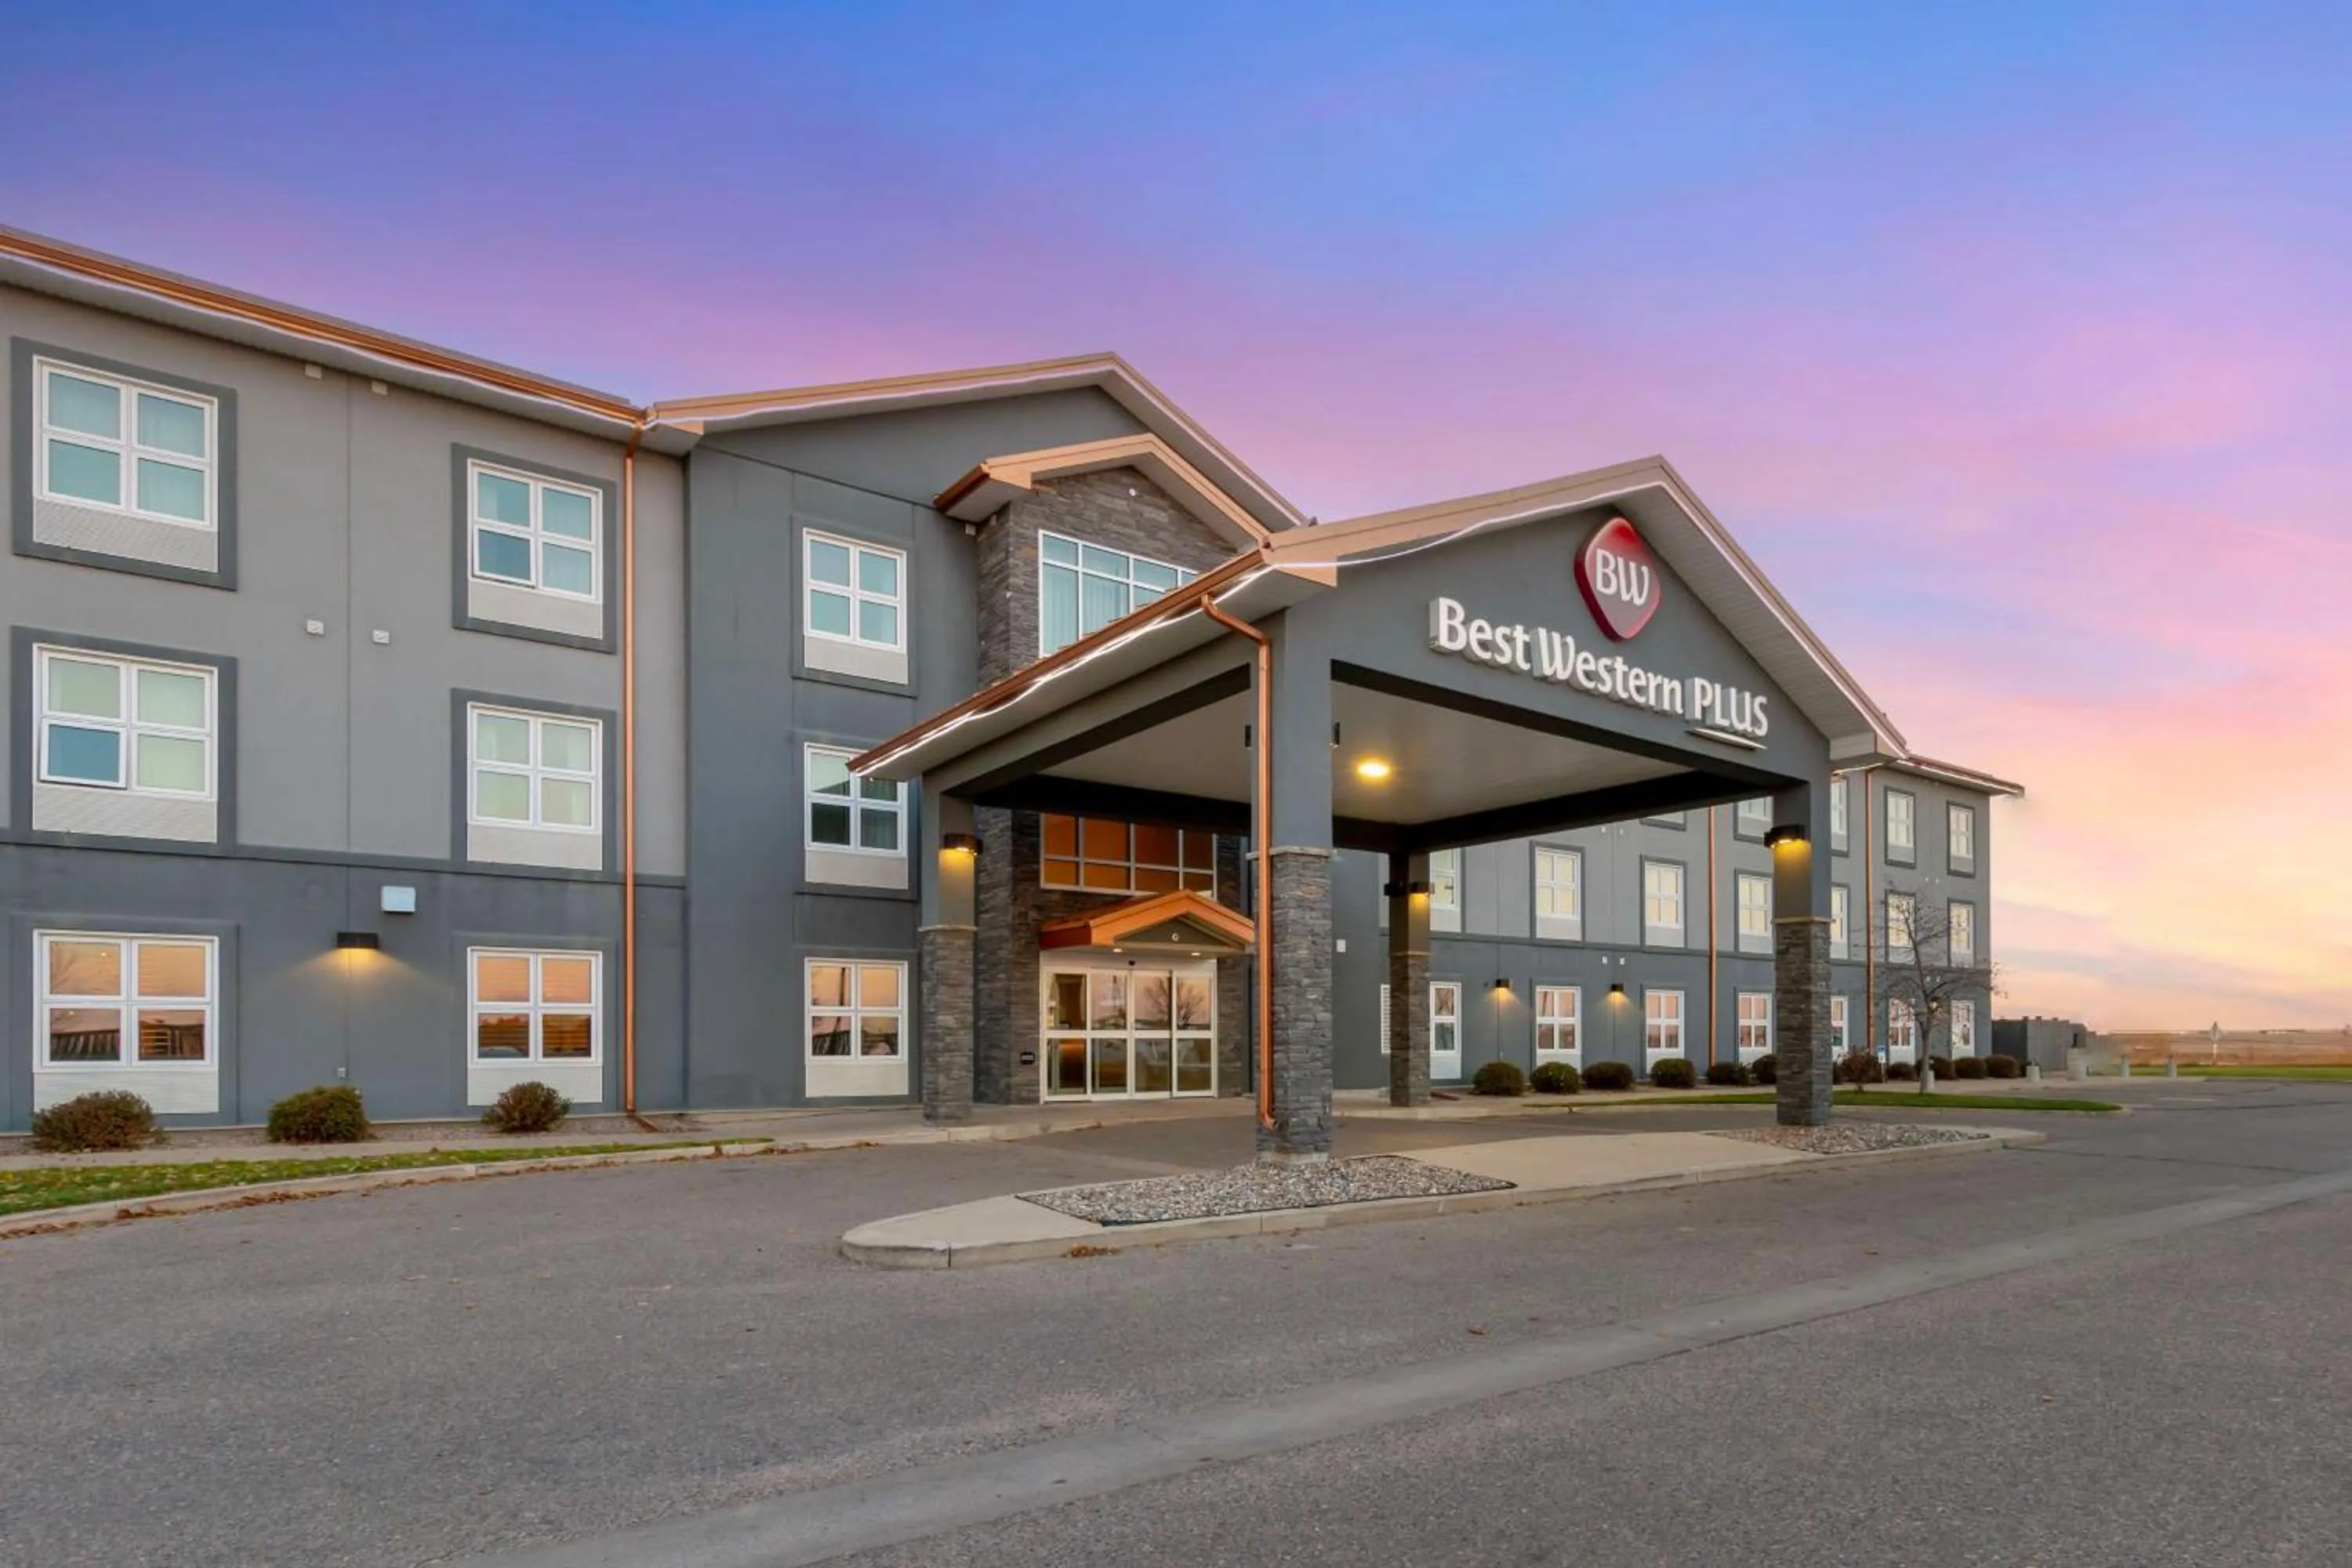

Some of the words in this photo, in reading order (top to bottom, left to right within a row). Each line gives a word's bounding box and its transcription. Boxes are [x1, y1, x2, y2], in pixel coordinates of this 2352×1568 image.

[1595, 548, 1649, 607] BW
[1435, 596, 1531, 671] Best
[1536, 627, 1684, 715] Western
[1690, 677, 1769, 737] PLUS
